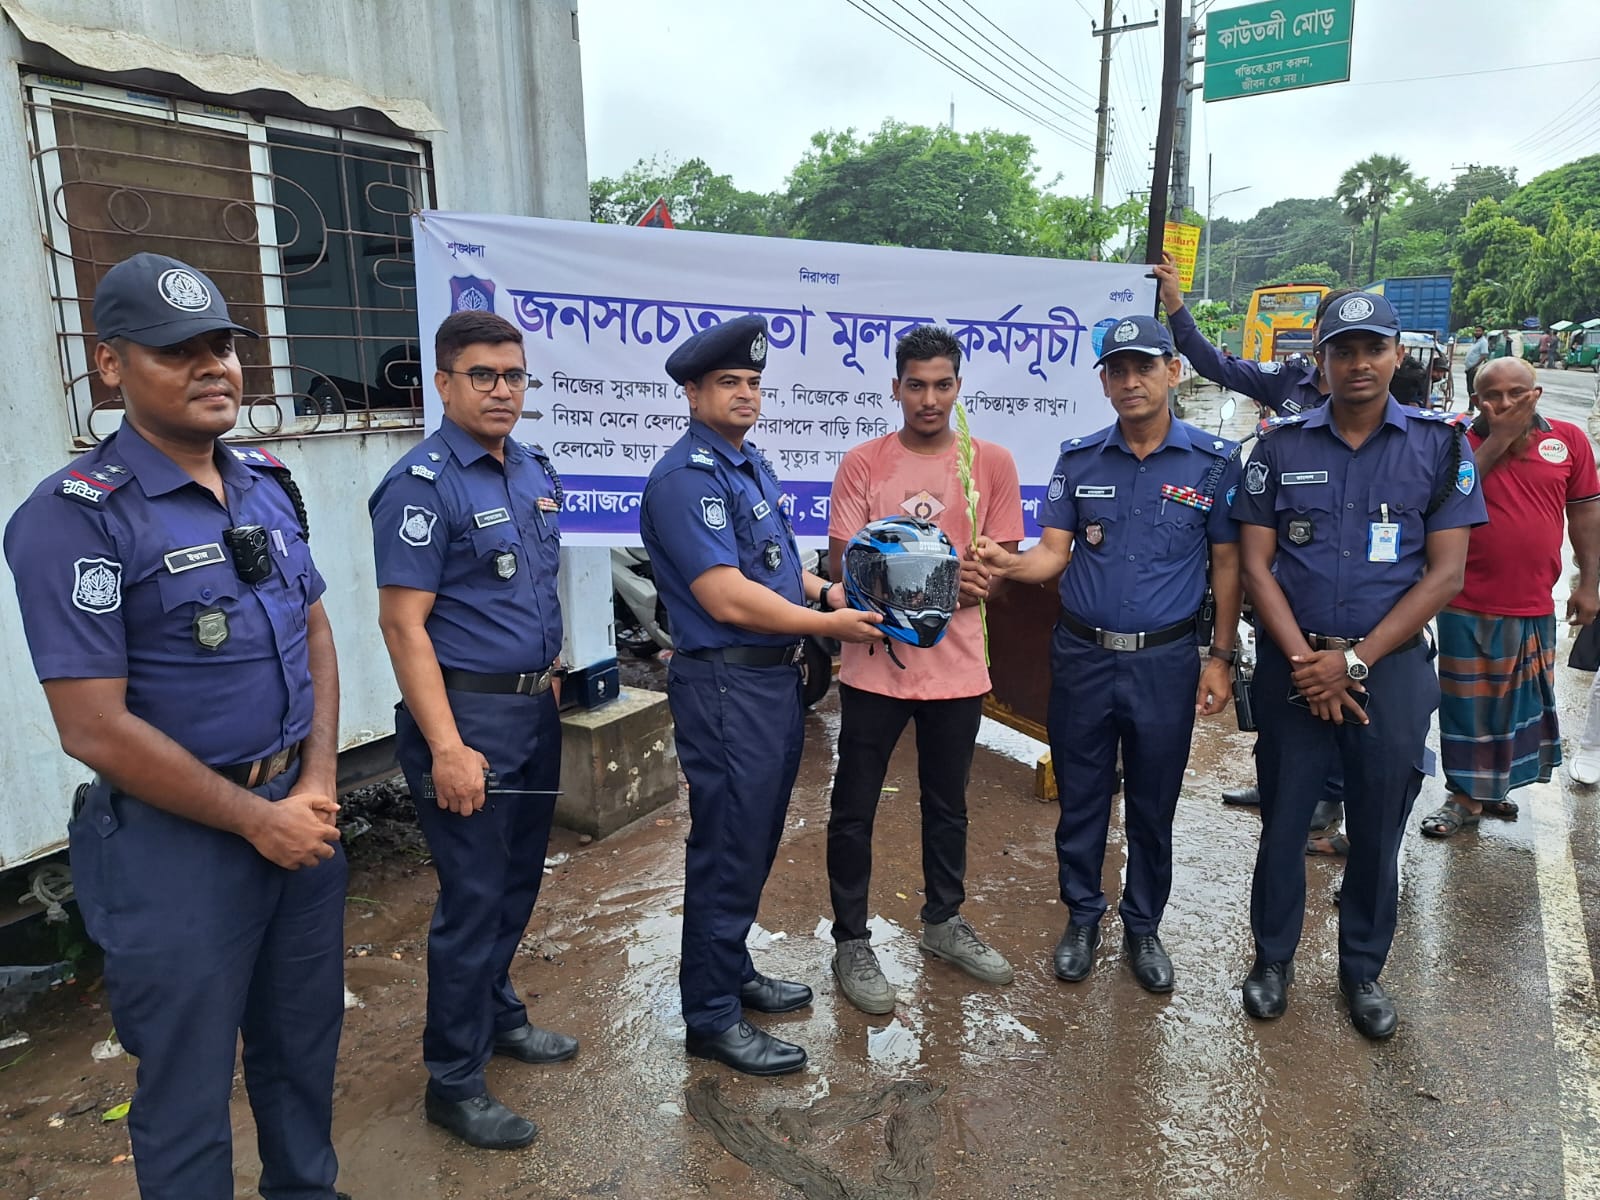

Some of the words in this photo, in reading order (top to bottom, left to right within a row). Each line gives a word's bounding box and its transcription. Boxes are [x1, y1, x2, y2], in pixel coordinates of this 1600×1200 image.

[1216, 9, 1287, 49] কাউতলী
[1292, 7, 1336, 36] মোড়
[446, 240, 486, 260] শৃঙ্খলা
[798, 266, 840, 286] নিরাপত্তা
[1109, 288, 1134, 304] প্রগতি
[505, 288, 815, 356] জনসচেততা
[945, 304, 1088, 381] কর্মসূচী
[552, 370, 605, 396] নিজের
[609, 380, 669, 402] সুরক্ষায়
[791, 382, 851, 407] নিজেকে
[854, 391, 882, 410] এবং
[963, 391, 1031, 416] দুশ্চিন্তামুক্ত
[552, 402, 594, 428] নিয়ম
[599, 410, 639, 430] মেনে
[644, 414, 691, 431] হেলমে
[819, 415, 851, 440] বাড়ি
[552, 437, 616, 459] হেলমেট
[620, 441, 659, 463] ছাড়া
[779, 449, 820, 472] মৃত্যুর
[62, 479, 103, 503] পুলিশ
